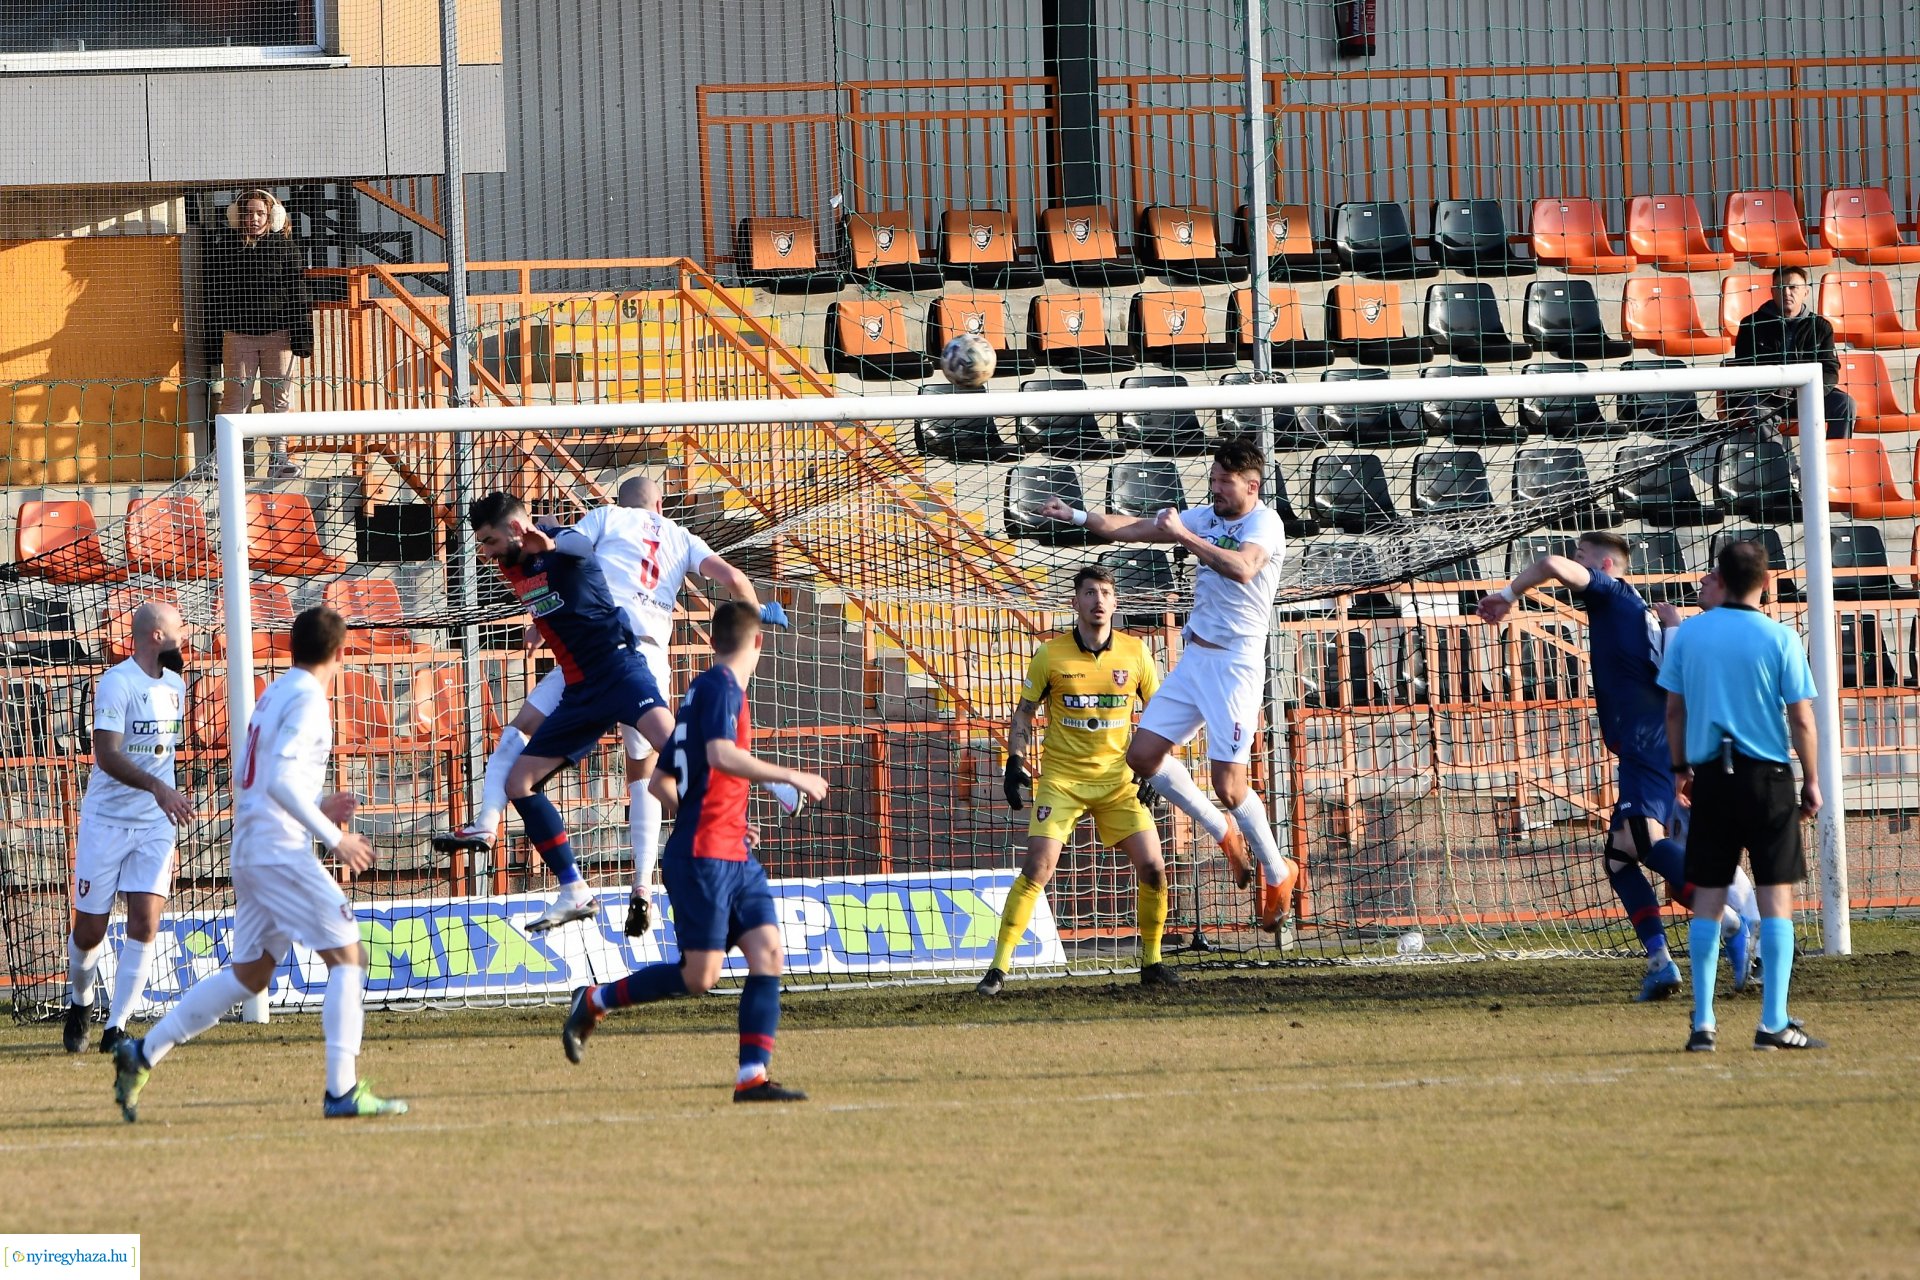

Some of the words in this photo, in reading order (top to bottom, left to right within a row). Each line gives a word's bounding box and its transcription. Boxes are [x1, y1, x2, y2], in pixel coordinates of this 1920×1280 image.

[622, 299, 638, 318] 6
[640, 538, 661, 590] 3
[1233, 721, 1242, 742] 5
